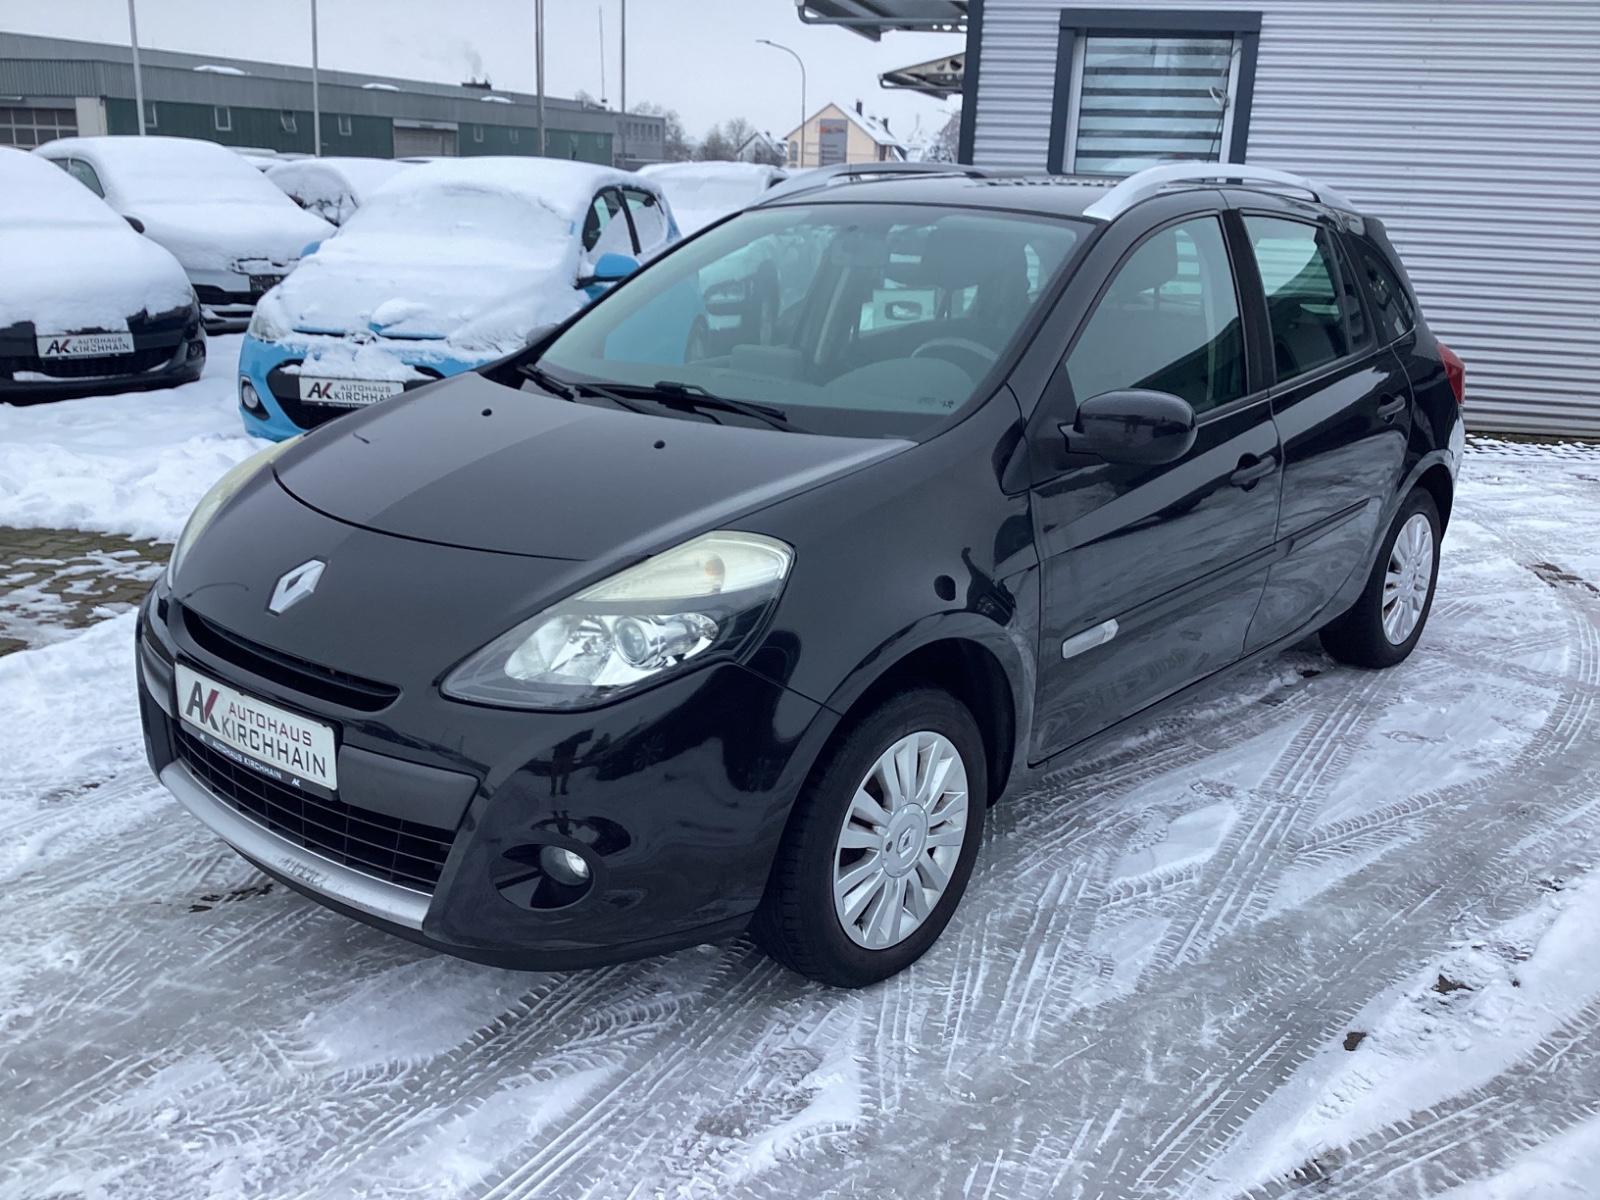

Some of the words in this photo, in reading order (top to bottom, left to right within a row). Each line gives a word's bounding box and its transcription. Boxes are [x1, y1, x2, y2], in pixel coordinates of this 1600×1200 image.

[45, 340, 71, 355] AK
[72, 343, 130, 353] KIRCHHAIN
[77, 337, 123, 345] AUTOHAUS
[307, 382, 333, 399] AK
[340, 384, 391, 393] AUTOHAUS
[186, 681, 220, 732] AK
[228, 702, 312, 746] AUTOHAUS
[222, 715, 326, 777] KIRCHHAIN
